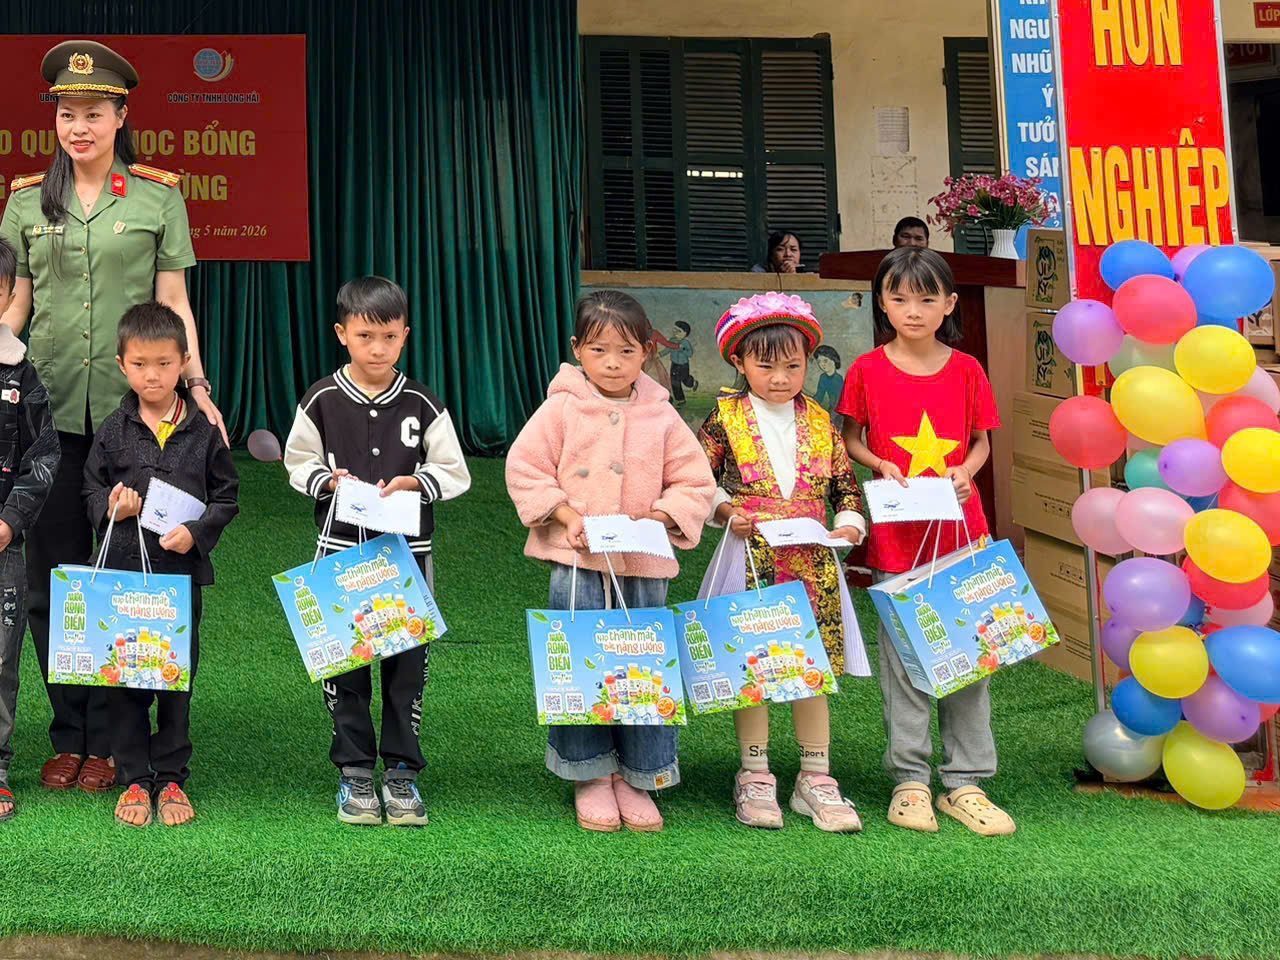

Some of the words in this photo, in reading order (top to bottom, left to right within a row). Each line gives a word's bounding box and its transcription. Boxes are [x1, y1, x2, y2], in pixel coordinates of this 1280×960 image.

[1010, 19, 1050, 39] NGU
[191, 93, 200, 103] TY
[202, 93, 222, 103] TNHH
[224, 93, 244, 103] LONG
[1042, 84, 1054, 108] Ý
[21, 129, 56, 158] QU
[184, 120, 256, 156] BỔNG
[1017, 115, 1055, 143] TƯỞ
[204, 225, 211, 236] 5
[213, 225, 237, 236] năm
[240, 225, 267, 236] 2026
[400, 416, 420, 448] C
